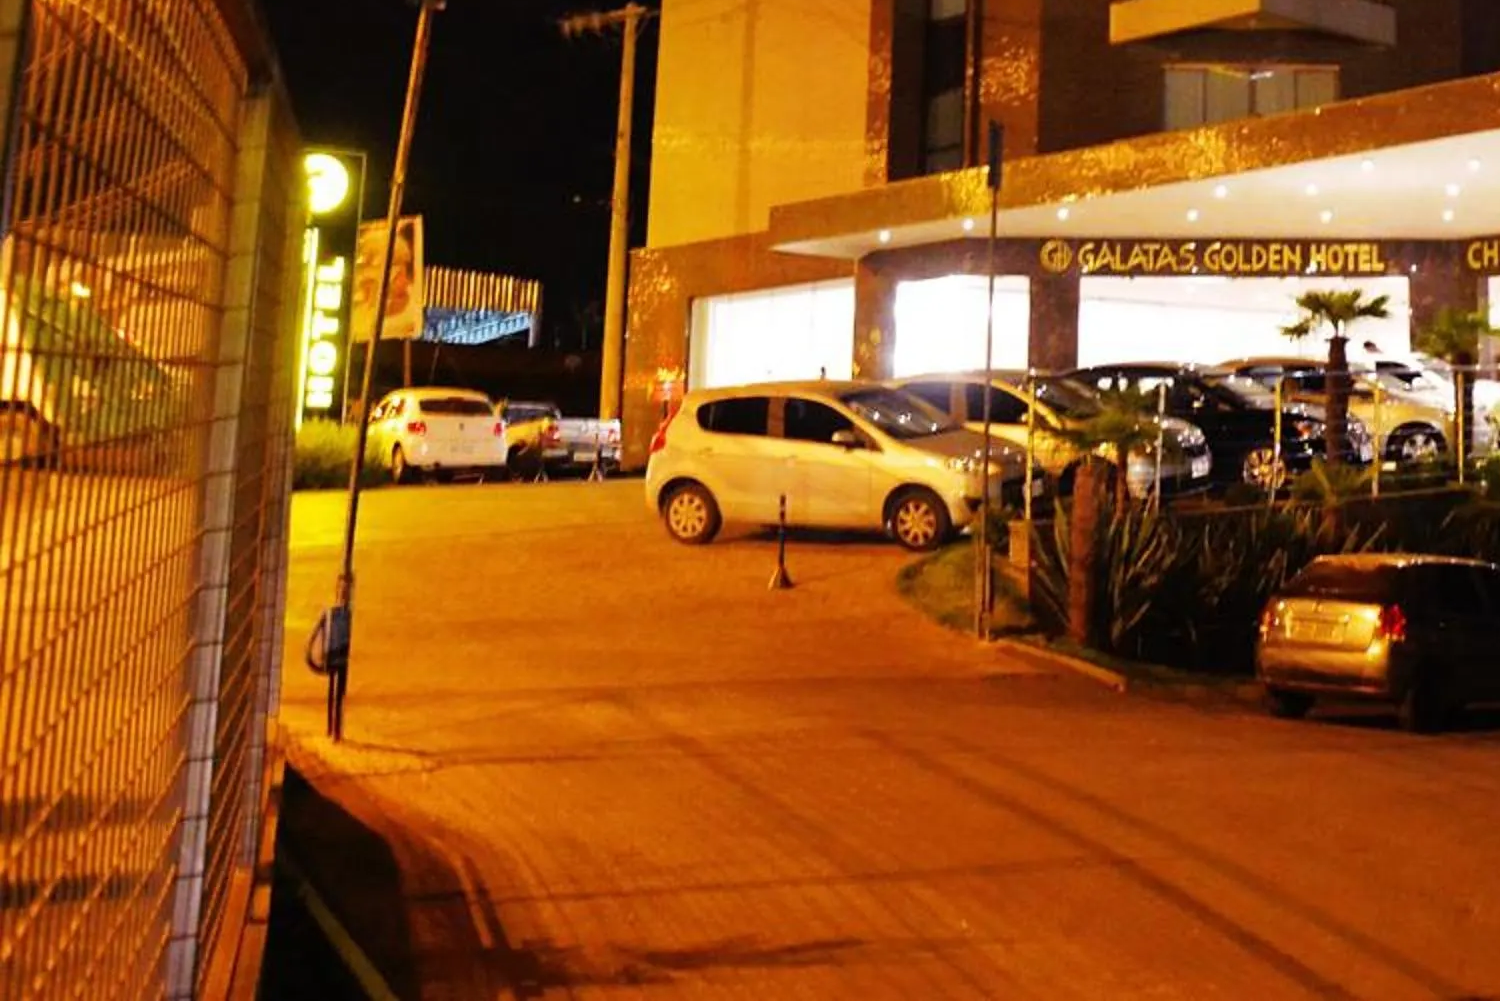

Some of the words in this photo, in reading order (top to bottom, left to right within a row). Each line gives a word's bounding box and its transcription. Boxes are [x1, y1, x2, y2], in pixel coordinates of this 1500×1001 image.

[1078, 241, 1197, 273] GALATAS
[1204, 242, 1302, 272] GOLDEN
[1308, 242, 1385, 273] HOTEL
[306, 255, 345, 408] HOTEL
